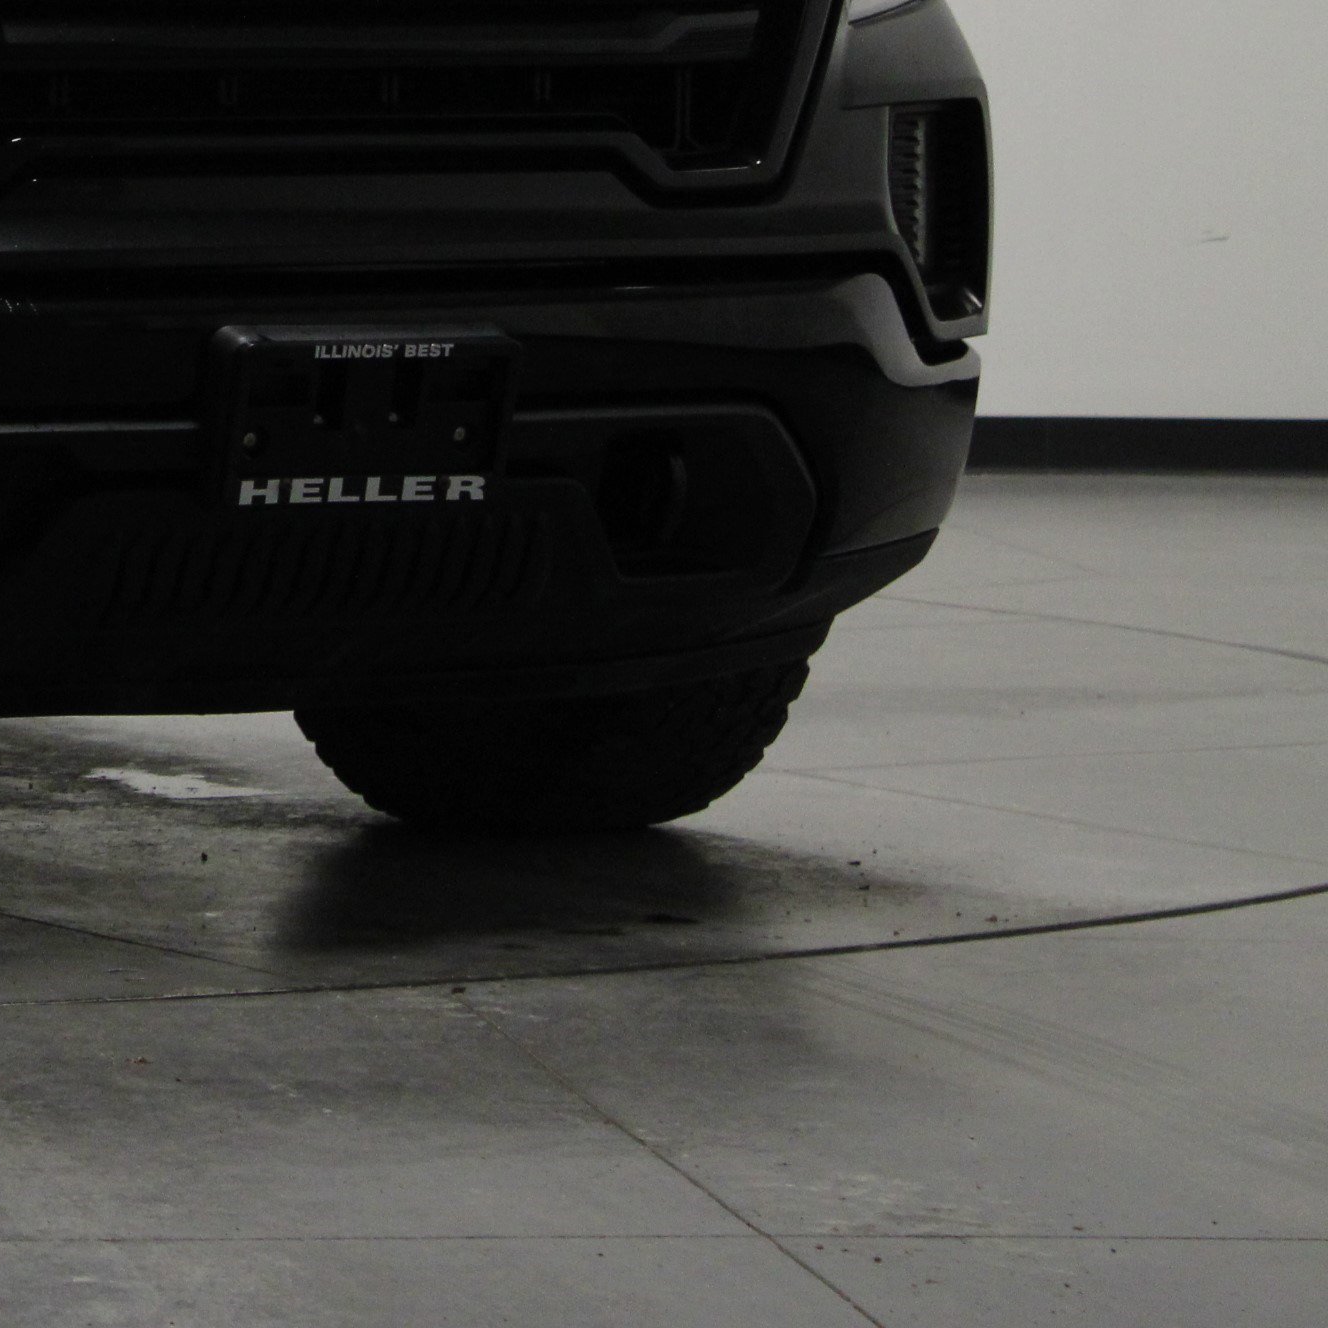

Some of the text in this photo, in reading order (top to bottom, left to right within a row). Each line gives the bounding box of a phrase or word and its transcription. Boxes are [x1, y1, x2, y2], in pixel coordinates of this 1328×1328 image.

[313, 343, 455, 359] ILLINOIS' BEST
[238, 475, 487, 506] HELLER
